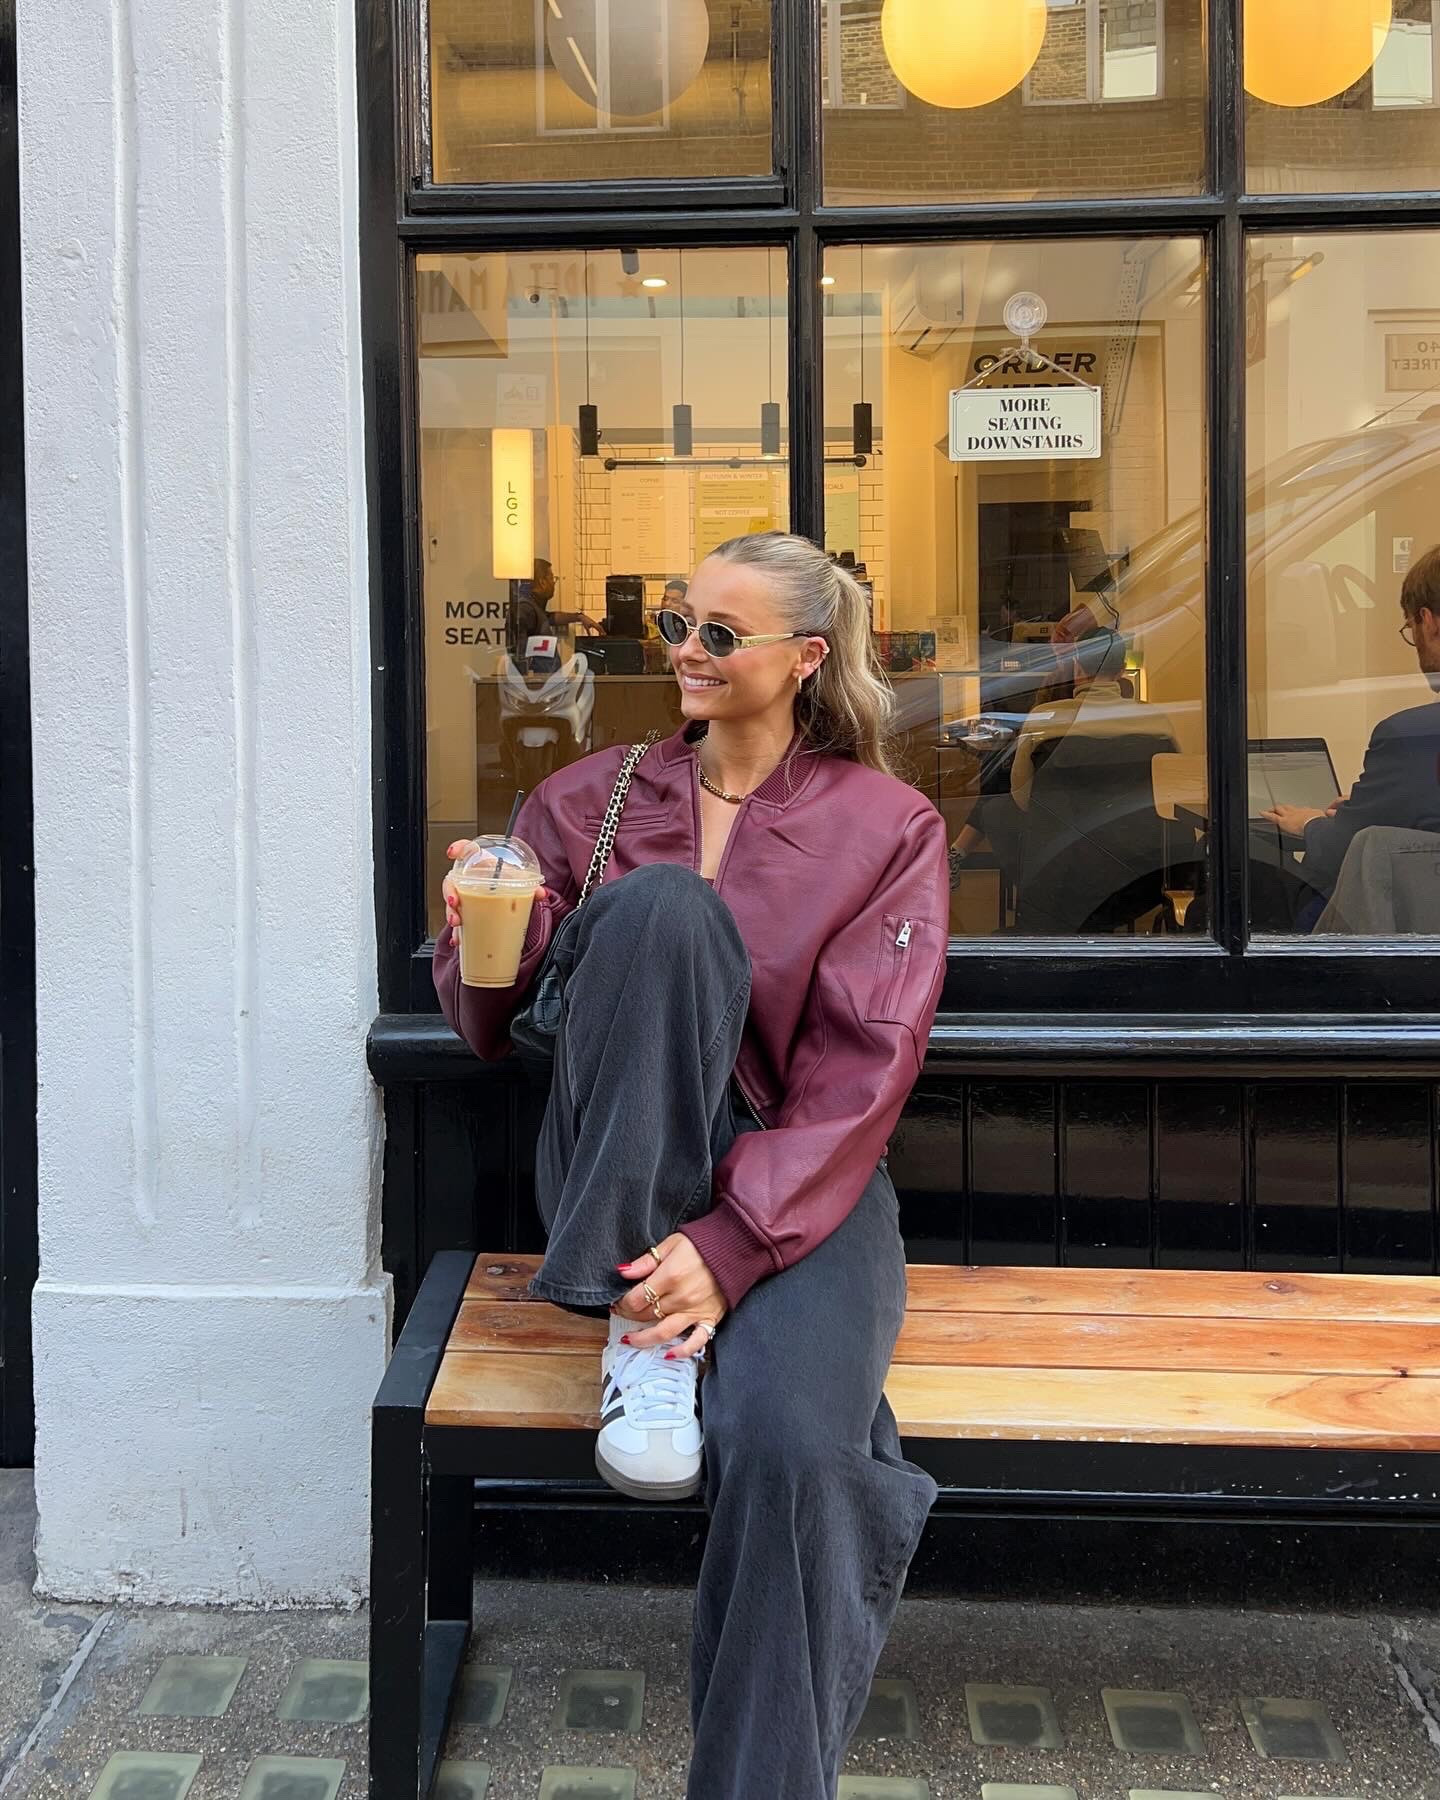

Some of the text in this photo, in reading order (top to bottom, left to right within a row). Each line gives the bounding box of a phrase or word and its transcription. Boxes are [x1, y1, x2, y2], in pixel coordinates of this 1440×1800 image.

[973, 352, 1097, 374] ORDER
[1000, 398, 1050, 413] MORE
[988, 416, 1062, 431] SEATING
[967, 434, 1083, 450] DOWNSTAIRS
[445, 627, 505, 645] SEAT
